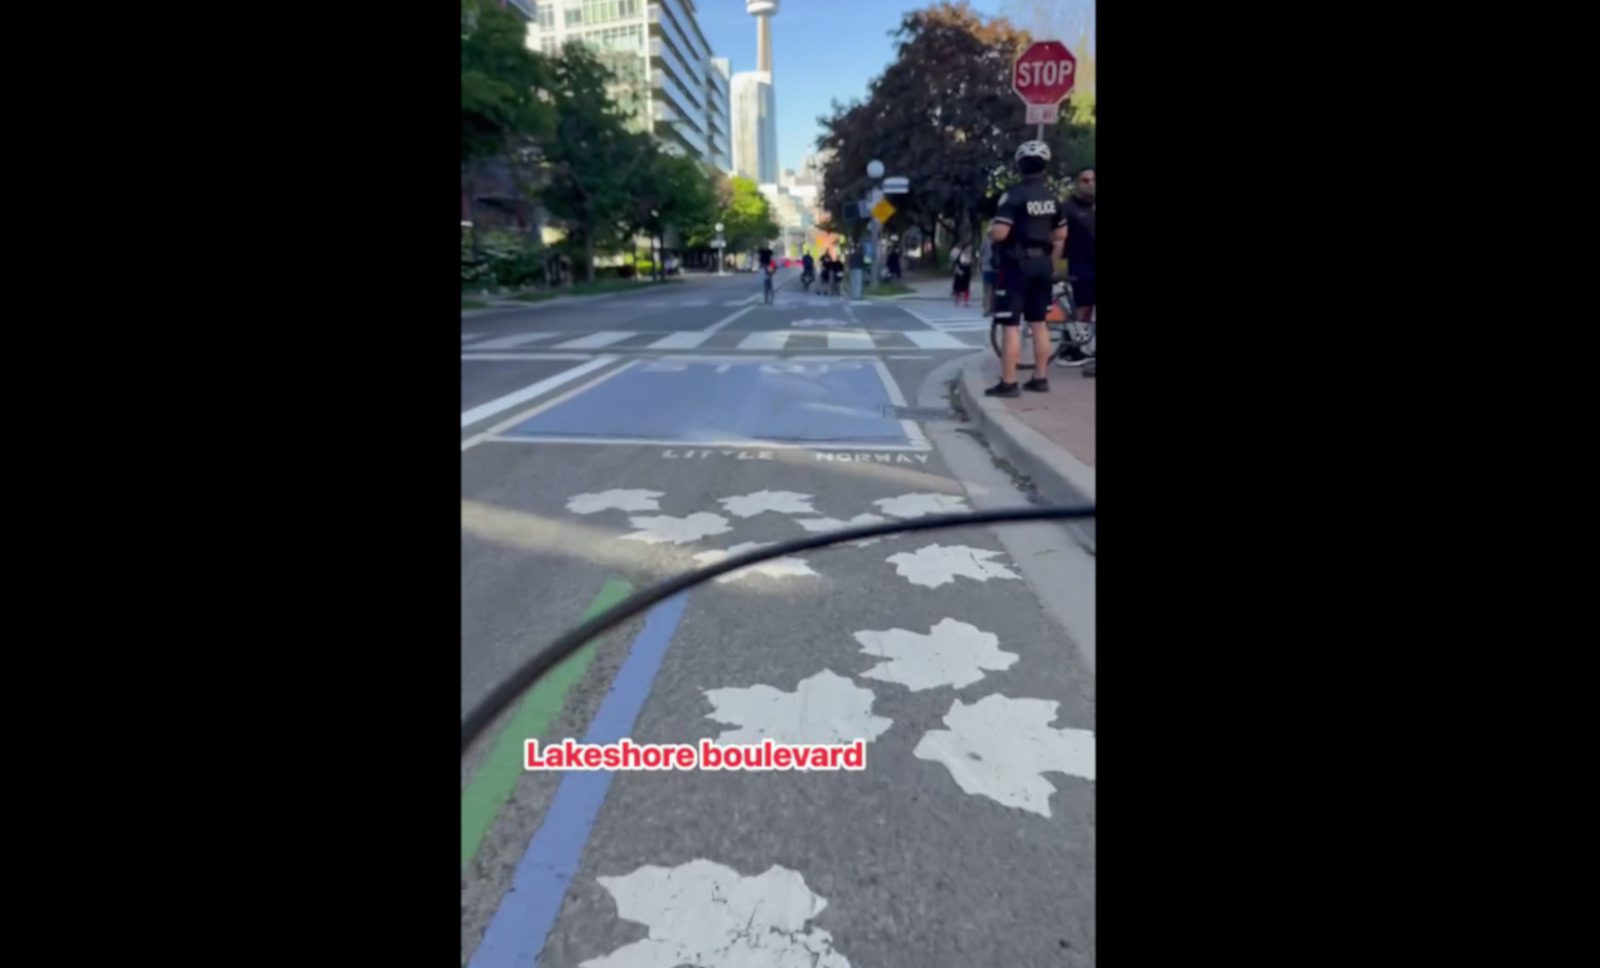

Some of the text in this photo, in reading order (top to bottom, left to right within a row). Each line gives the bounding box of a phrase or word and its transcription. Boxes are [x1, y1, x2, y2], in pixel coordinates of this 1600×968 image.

[1017, 61, 1072, 87] STOP
[1026, 201, 1056, 215] POLICE
[661, 448, 928, 464] LITTLE NORWAY
